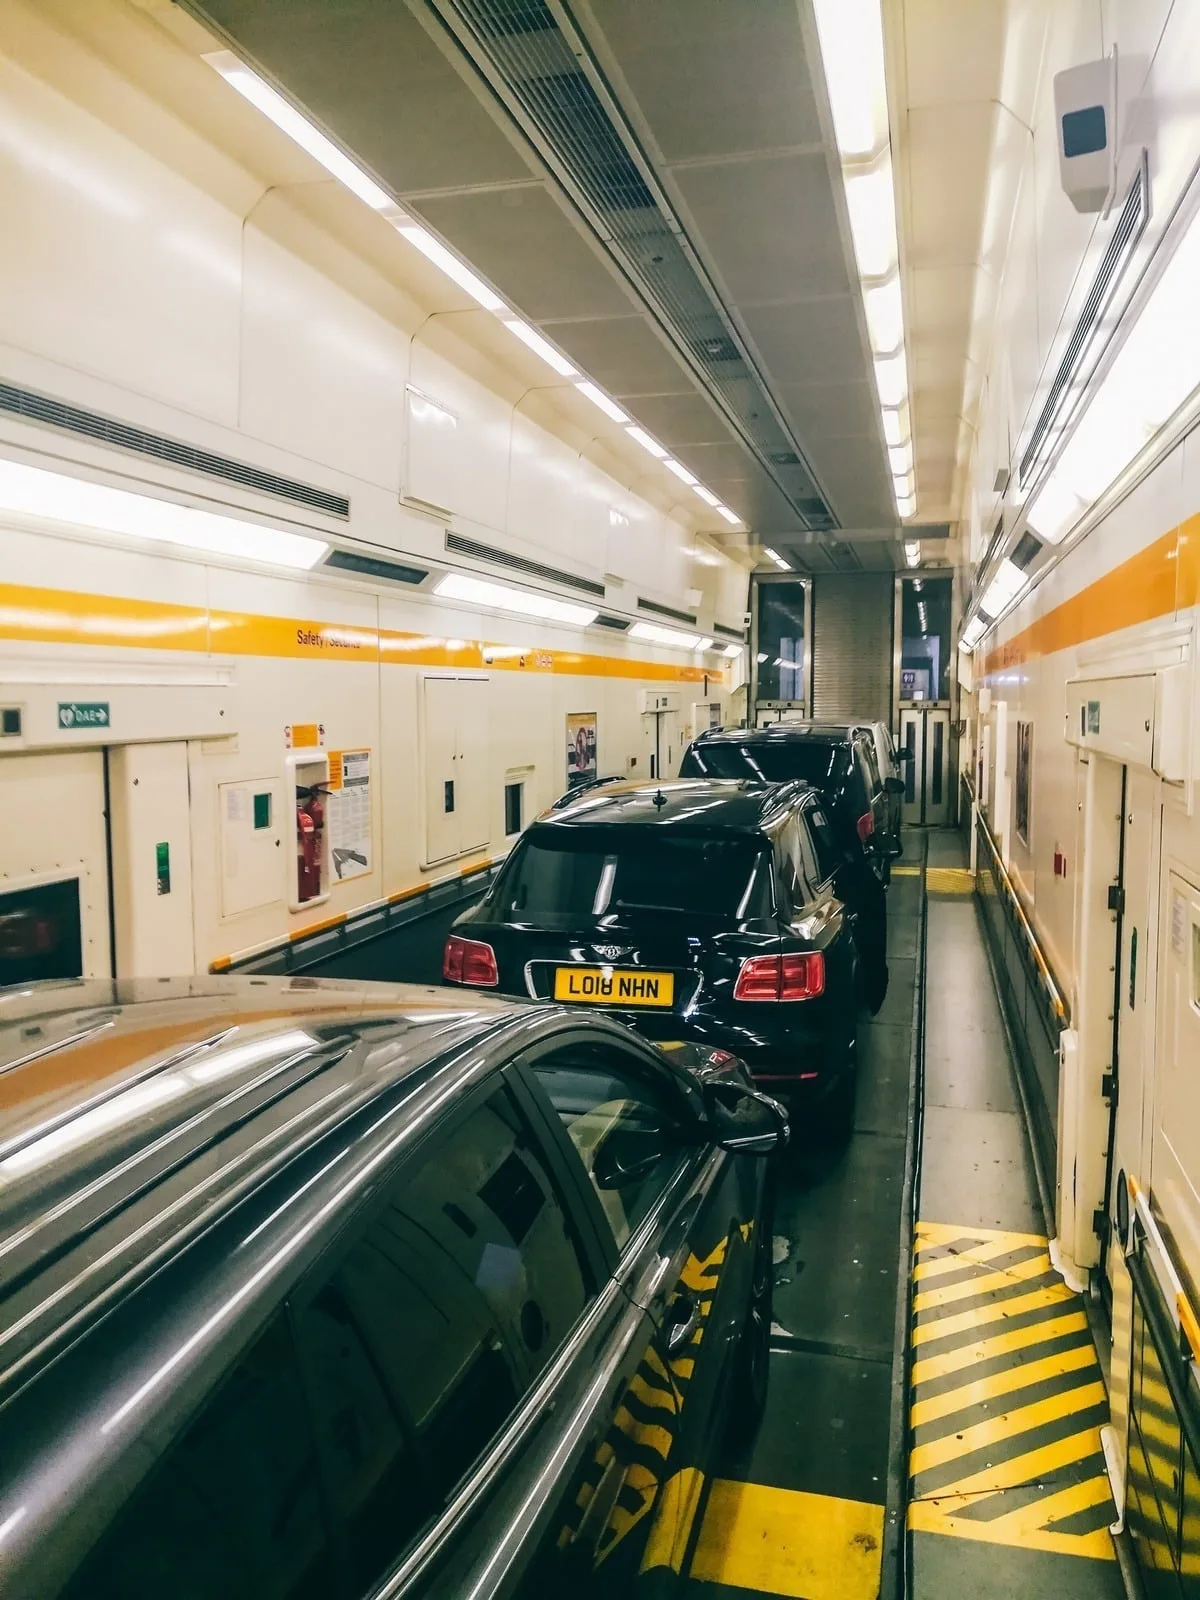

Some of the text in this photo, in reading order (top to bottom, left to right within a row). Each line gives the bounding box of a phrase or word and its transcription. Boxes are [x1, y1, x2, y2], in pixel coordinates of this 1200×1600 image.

[297, 629, 323, 648] Safety
[76, 710, 96, 721] DAE
[569, 975, 660, 998] LO18 NHN
